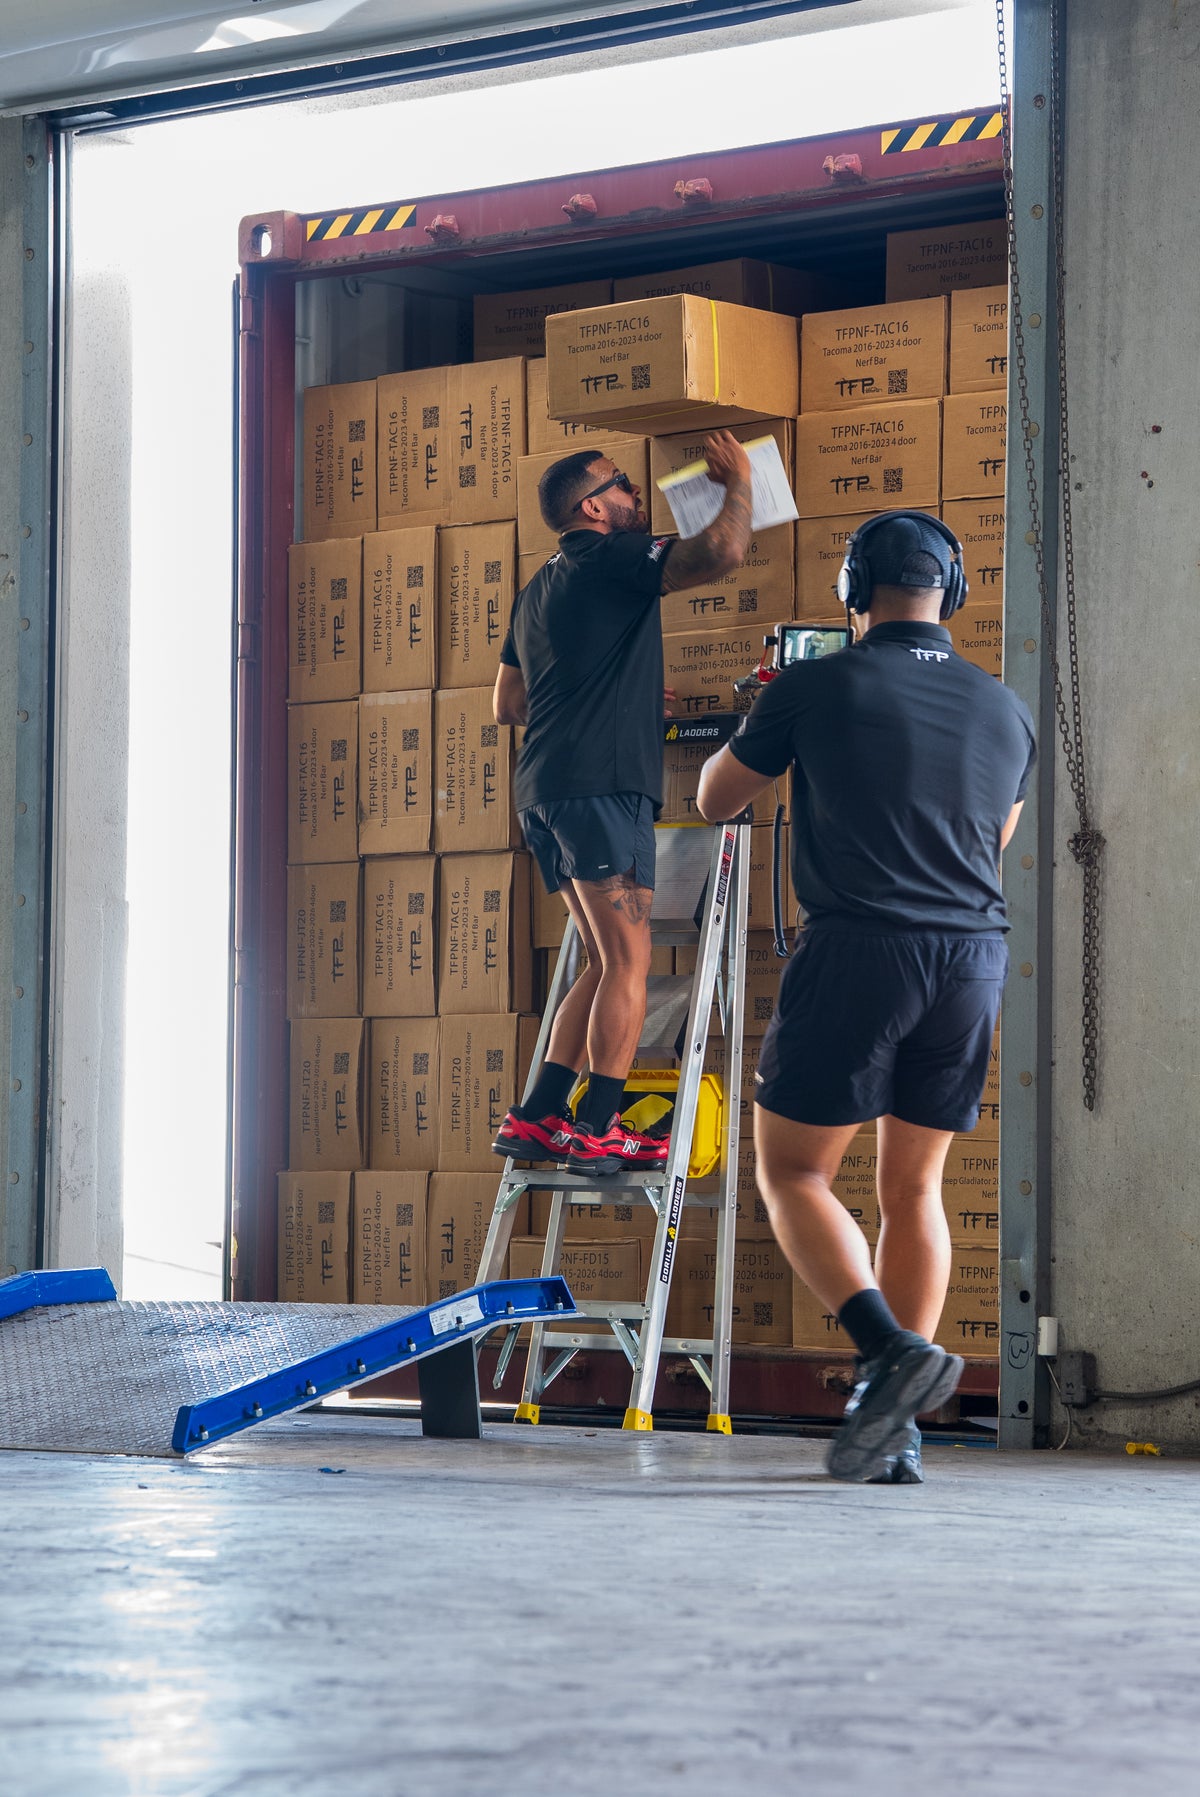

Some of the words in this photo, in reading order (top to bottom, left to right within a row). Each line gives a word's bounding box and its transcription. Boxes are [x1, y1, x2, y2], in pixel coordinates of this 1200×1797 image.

[920, 237, 993, 257] TFPNF-TAC16
[907, 262, 937, 273] Tacoma
[938, 255, 979, 268] 2016-2023
[986, 252, 1005, 263] door
[939, 273, 957, 283] Nerf
[958, 273, 970, 281] Bar
[579, 316, 650, 338] TFPNF-TAC16
[836, 321, 909, 341] TFPNF-TAC16
[973, 321, 1004, 333] Tacoma
[568, 343, 595, 355] Tacoma
[598, 337, 636, 350] 2016-2023
[644, 332, 662, 342] door
[823, 346, 852, 357] Tacoma
[853, 340, 895, 353] 2016-2023
[902, 337, 921, 346] door
[600, 353, 617, 364] Nerf
[618, 352, 629, 362] Bar
[855, 357, 873, 367] Nerf
[874, 356, 887, 365] Bar
[581, 373, 618, 395] TFP
[834, 378, 875, 397] TFP
[460, 403, 473, 449] TFP
[831, 420, 904, 440] TFPNF-TAC16
[966, 425, 996, 435] Tacoma
[501, 398, 511, 482] TFPNF-TAC16
[818, 443, 847, 454] Tacoma
[849, 438, 890, 451] 2016-2023
[891, 438, 897, 446] 4
[898, 436, 917, 446] door
[389, 411, 398, 495] TFPNF-TAC16
[851, 455, 869, 465] Nerf
[869, 455, 882, 464] Bar
[316, 424, 324, 507] TFPNF-TAC16
[424, 444, 437, 489] TFP
[350, 458, 363, 502] TFP
[830, 476, 869, 495] TFP
[965, 532, 995, 542] Tacoma
[752, 558, 770, 566] door
[725, 576, 737, 584] Bar
[374, 570, 382, 653] TFPNF-TAC16
[451, 565, 459, 649] TFPNF-TAC16
[688, 596, 726, 615] TFP
[298, 582, 306, 664] TFPNF-TAC16
[408, 604, 421, 649] TFP
[486, 599, 499, 645] TFP
[332, 616, 345, 660] TFP
[960, 639, 992, 648] Tacoma
[681, 641, 750, 659] TFPNF-TAC16
[910, 648, 949, 662] TFP
[669, 664, 697, 673] Tacoma
[699, 658, 738, 671] 2016-2023
[701, 677, 718, 685] Nerf
[719, 675, 731, 683] Bar
[682, 695, 720, 713] TFP
[679, 728, 719, 737] LADDERS
[370, 731, 378, 815] TFPNF-TAC16
[447, 728, 456, 811] TFPNF-TAC16
[671, 764, 698, 773] Tacoma
[404, 767, 417, 812] TFP
[482, 763, 496, 809] TFP
[332, 777, 345, 821] TFP
[461, 877, 470, 897] door
[376, 894, 384, 978] TFPNF-TAC16
[450, 891, 460, 975] TFPNF-TAC16
[461, 907, 470, 953] 2016-2023
[298, 910, 306, 981] TFPNF-JT20
[409, 931, 421, 975] TFP
[484, 928, 496, 974] TFP
[331, 938, 344, 983] TFP
[461, 955, 470, 990] Tacoma
[303, 1061, 311, 1133] TFPNF-JT20
[452, 1058, 461, 1132] TFPNF-JT20
[336, 1090, 347, 1135] TFP
[415, 1091, 428, 1136] TFP
[487, 1088, 501, 1134] TFP
[623, 1139, 641, 1155] N
[846, 1187, 861, 1195] Nerf
[941, 1177, 958, 1185] Jeep
[959, 1176, 991, 1185] Gladiator
[982, 1190, 997, 1198] Nerf
[473, 1201, 482, 1227] F150
[958, 1209, 998, 1230] TFP
[441, 1217, 453, 1263] TFP
[662, 1241, 673, 1282] GORILLA
[672, 1181, 683, 1225] LADDERS
[286, 1206, 294, 1282] TFPNF-FD15
[322, 1240, 333, 1285] TFP
[398, 1243, 411, 1288] TFP
[598, 1269, 623, 1279] 4door
[689, 1271, 710, 1280] F150
[759, 1270, 784, 1280] 4door
[581, 1282, 593, 1291] Bar
[740, 1285, 754, 1293] Bar
[956, 1285, 989, 1294] Gladiator
[980, 1299, 995, 1308] Nerf
[956, 1318, 999, 1338] TFP
